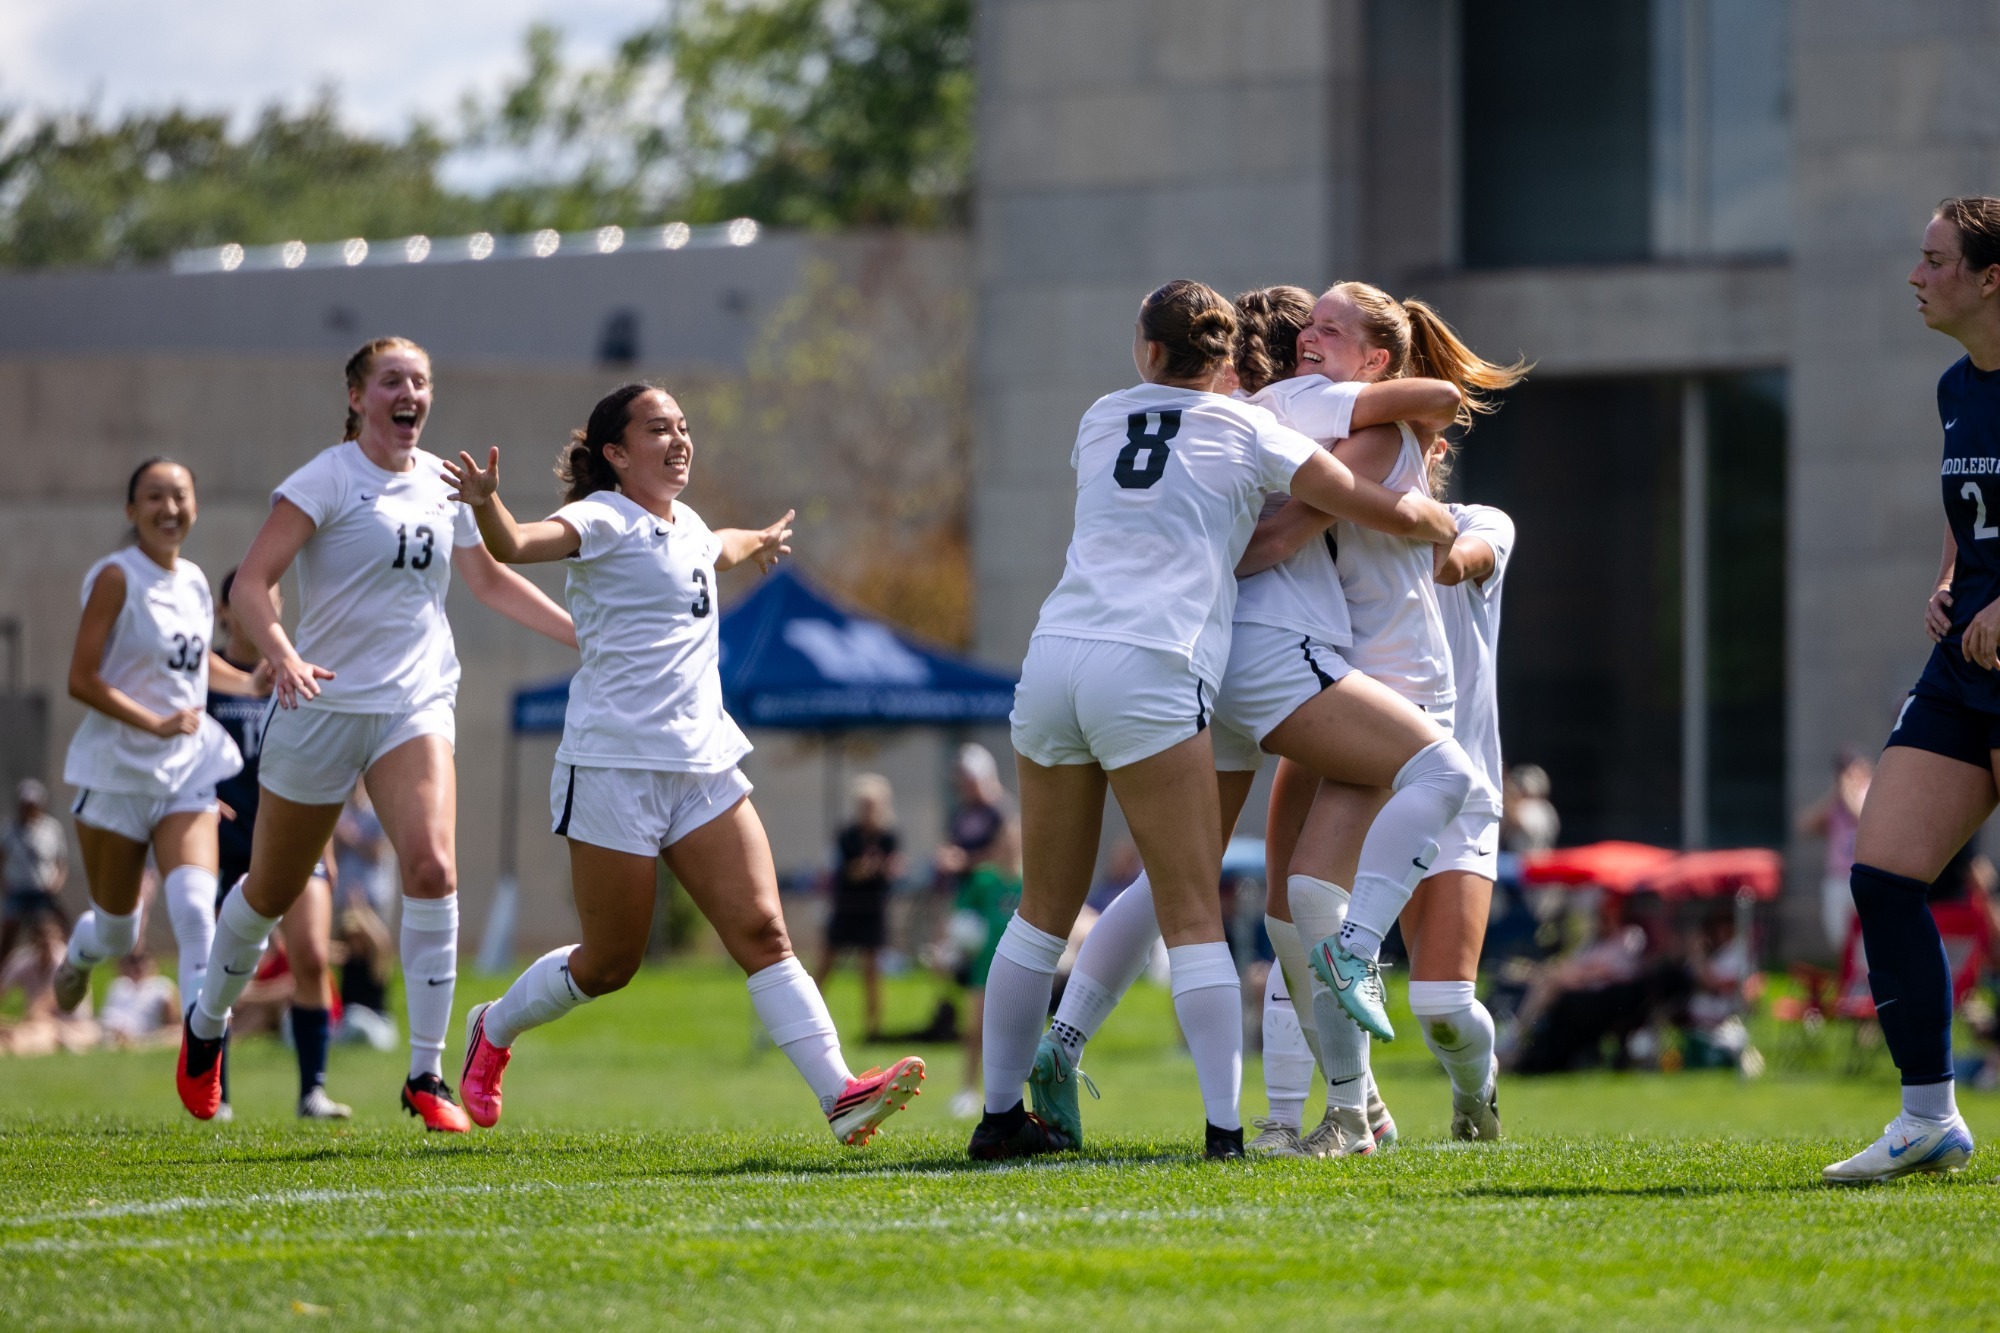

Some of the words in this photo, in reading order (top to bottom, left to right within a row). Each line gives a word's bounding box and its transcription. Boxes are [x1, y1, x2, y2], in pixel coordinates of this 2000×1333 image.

[1113, 409, 1182, 489] 8
[1960, 481, 1999, 540] 2
[392, 523, 434, 571] 13
[691, 568, 710, 618] 3
[167, 633, 204, 673] 33
